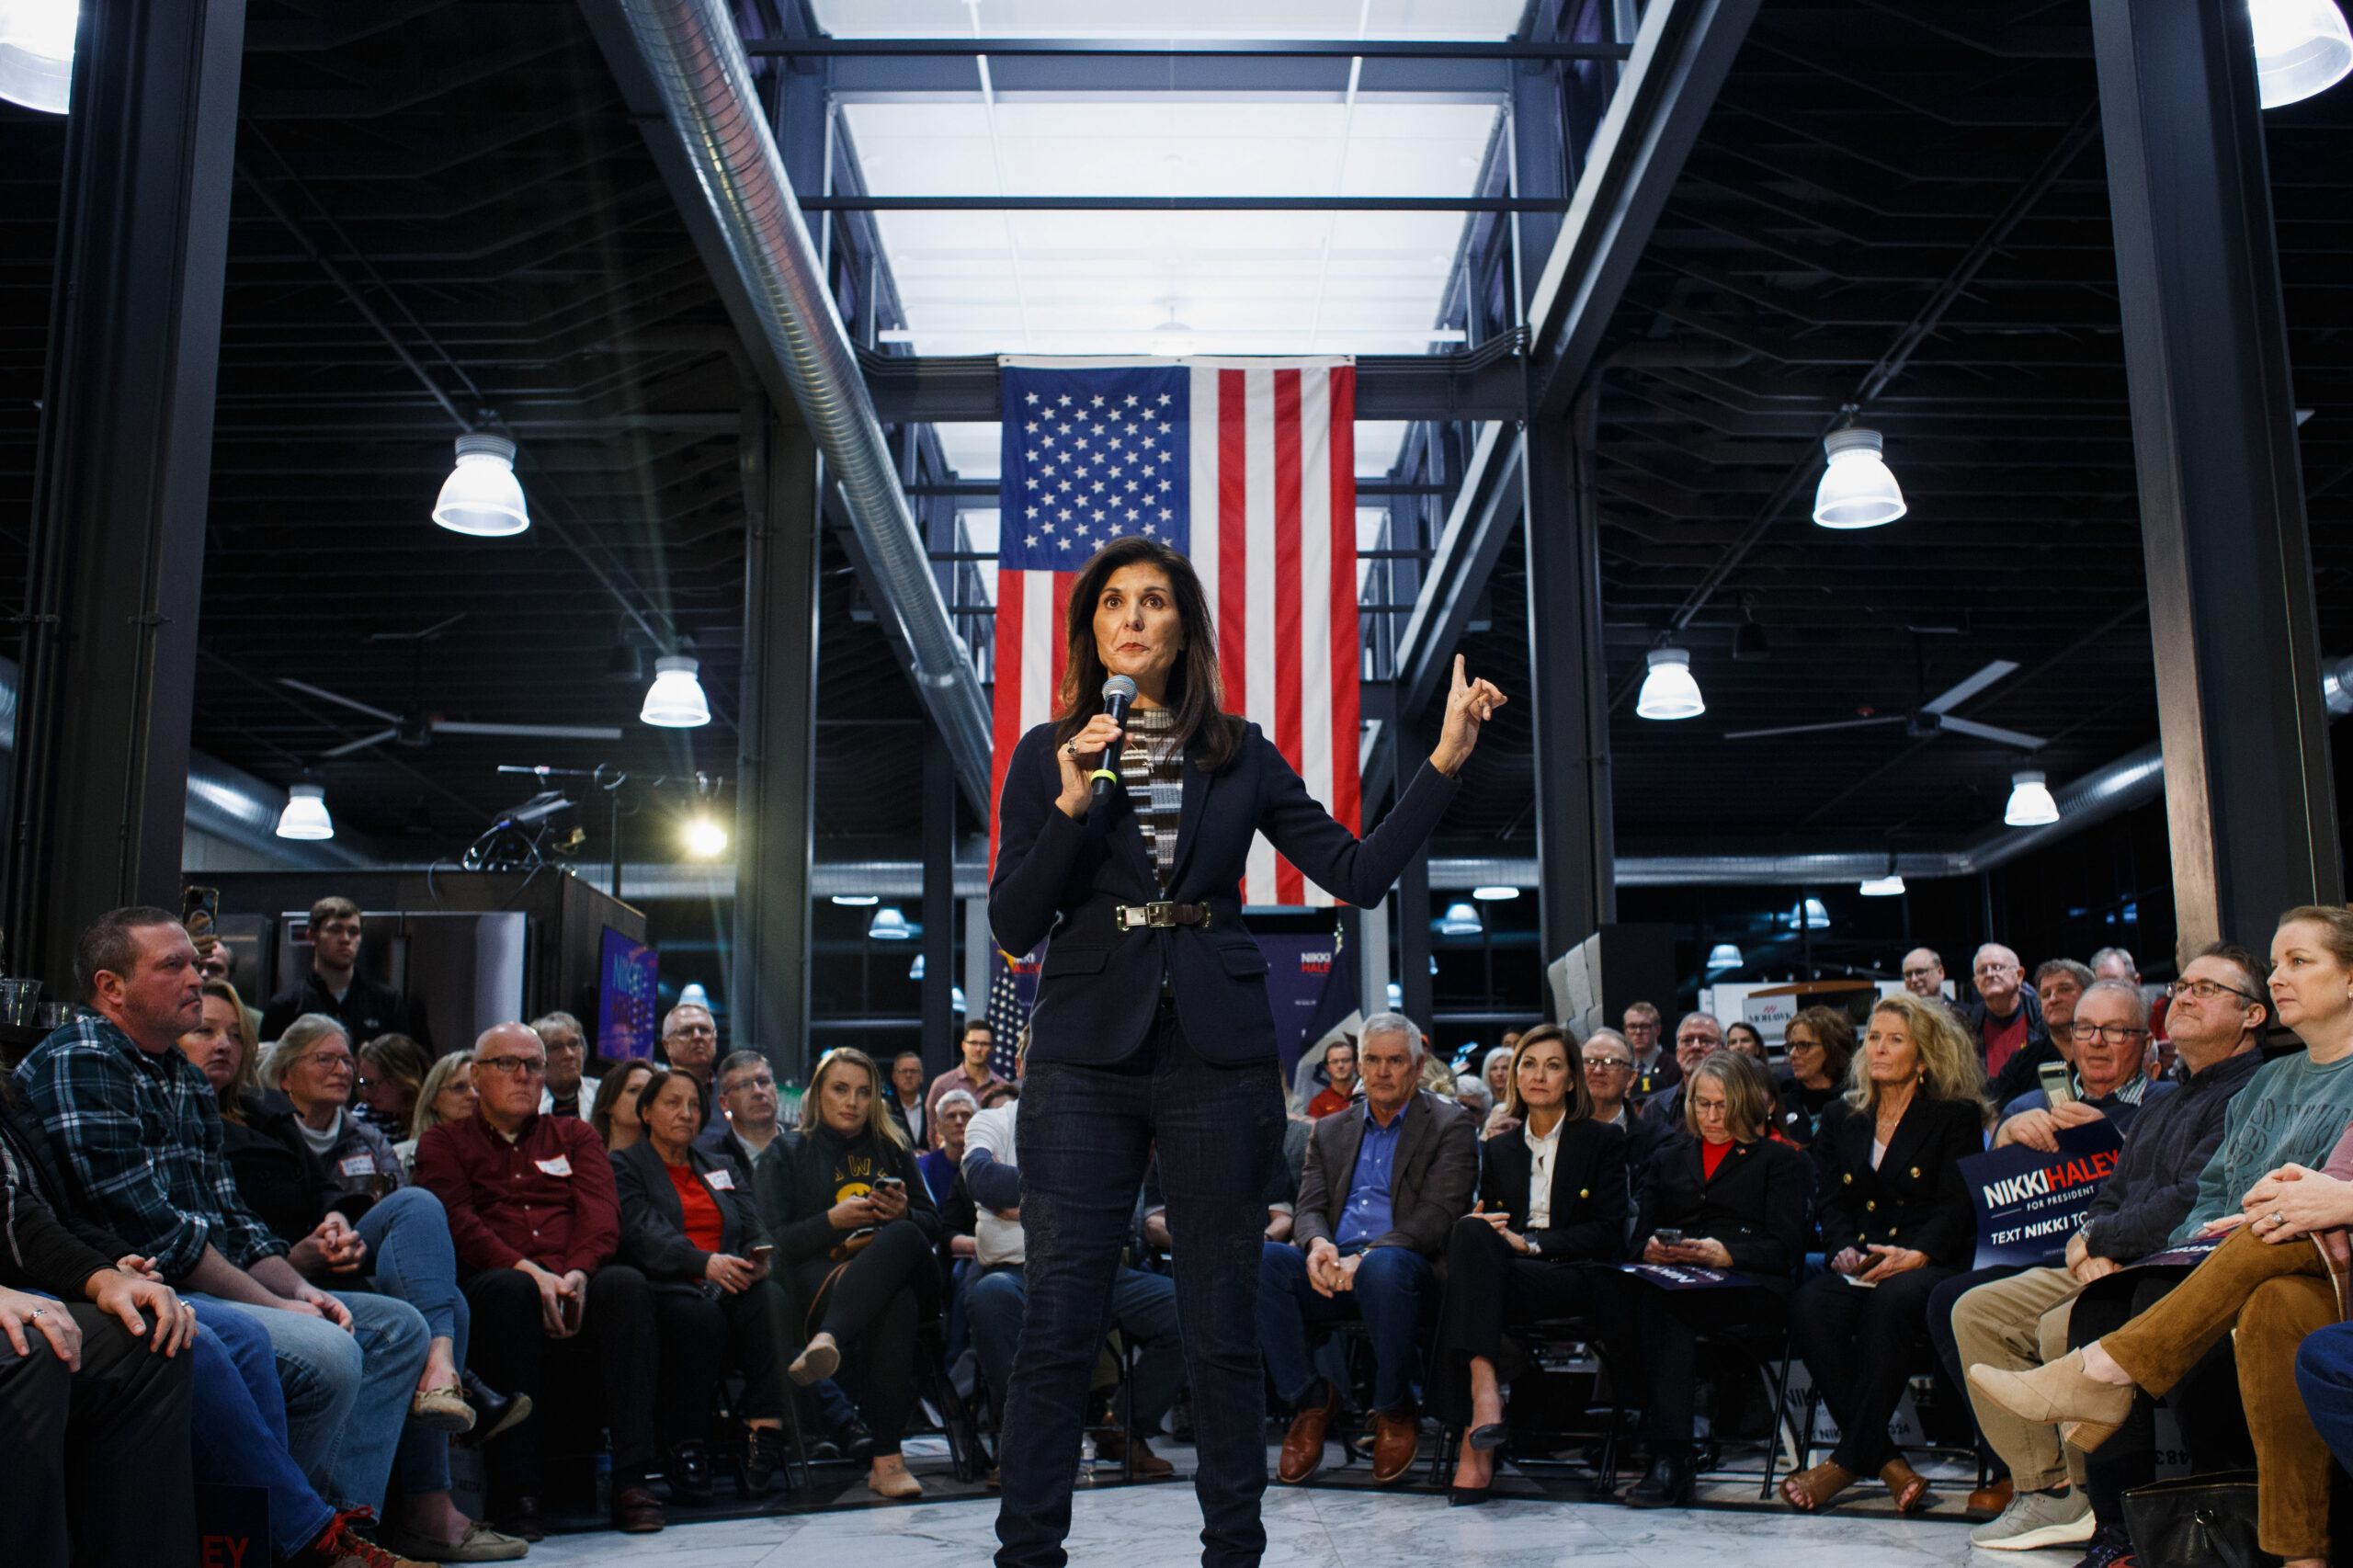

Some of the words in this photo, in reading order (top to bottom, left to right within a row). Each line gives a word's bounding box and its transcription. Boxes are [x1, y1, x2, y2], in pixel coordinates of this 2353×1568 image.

[1301, 963, 1333, 973] HALE
[2027, 1201, 2045, 1212] FOR
[2048, 1185, 2095, 1206] PRESIDENT
[1991, 1228, 2022, 1245] TEXT
[2025, 1216, 2069, 1239] NIKKI
